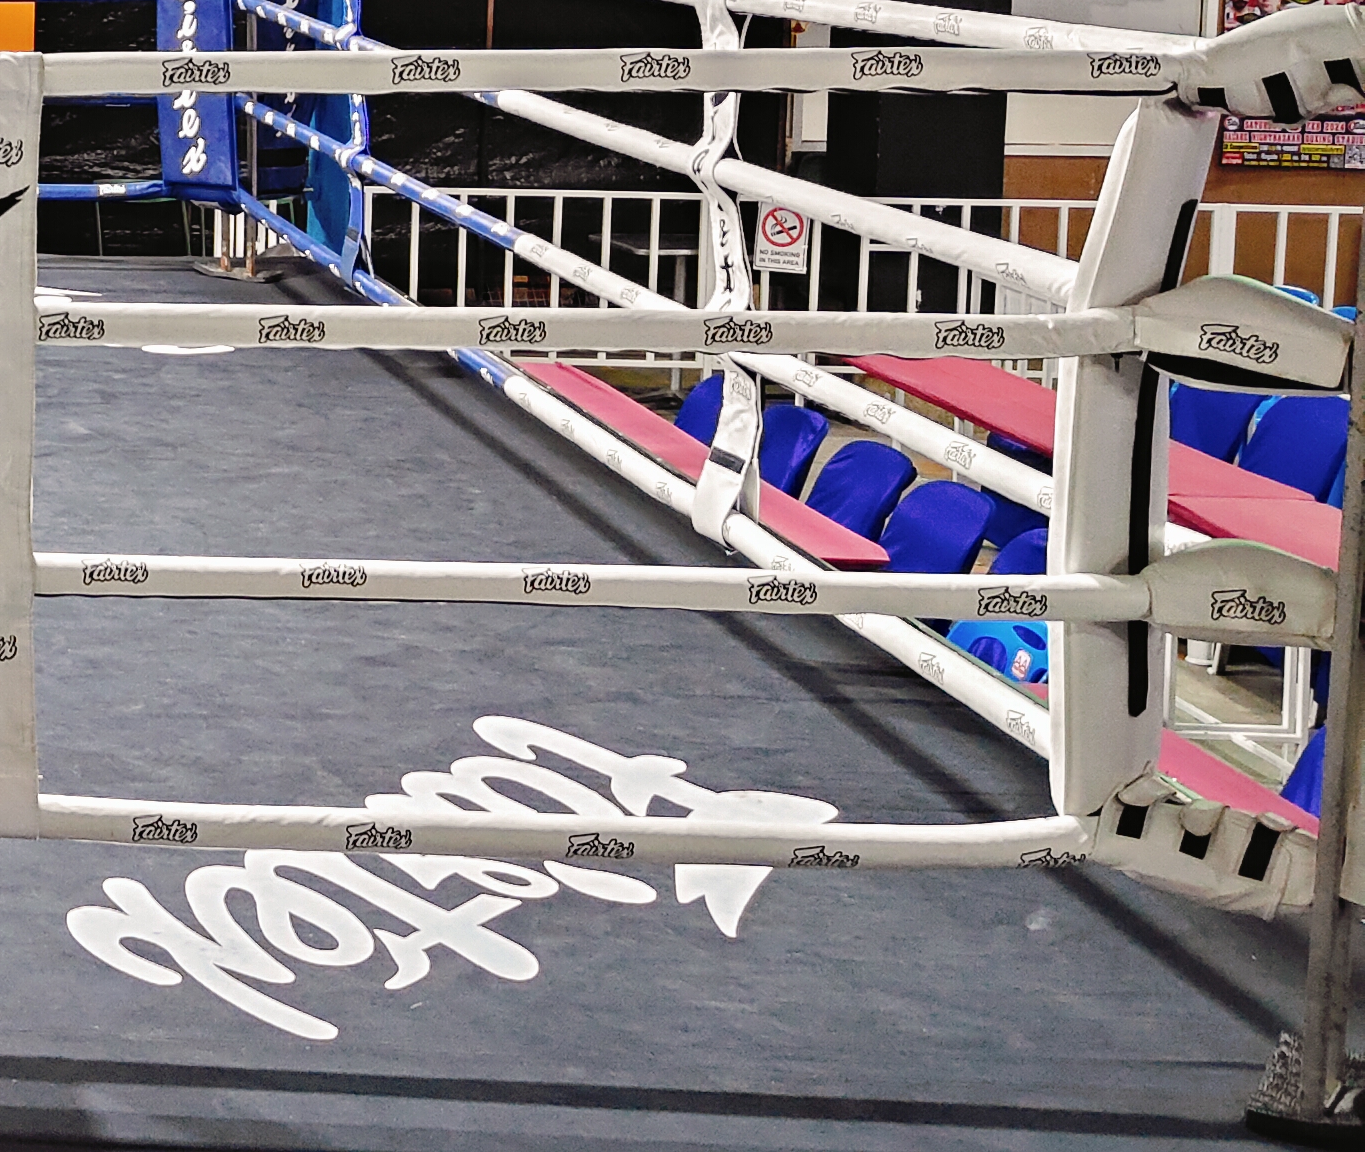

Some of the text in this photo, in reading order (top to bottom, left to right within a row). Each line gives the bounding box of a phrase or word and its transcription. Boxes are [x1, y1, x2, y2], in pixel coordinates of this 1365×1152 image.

[162, 57, 230, 87] Fairtex
[391, 54, 460, 83] Fairtex
[620, 52, 690, 82] Fairtex
[852, 51, 923, 81] Fairtex
[1089, 50, 1161, 78] Fairtex
[39, 312, 104, 341] Fairtex
[258, 315, 325, 344] Fairtex
[479, 316, 546, 345] Fairtex
[703, 317, 772, 346] Fairtex
[935, 320, 1004, 350] Fairtex
[1199, 324, 1279, 364] Fairtex
[82, 559, 148, 586] Fairtex
[301, 563, 367, 590] Fairtex
[523, 567, 590, 598] Fairtex
[748, 575, 817, 605] Fairtex
[977, 587, 1047, 617] Fairtex
[1211, 590, 1286, 625] Fairtex
[132, 815, 198, 844] Fairtex
[346, 823, 413, 850] Fairtex
[567, 834, 634, 860] Fairtex
